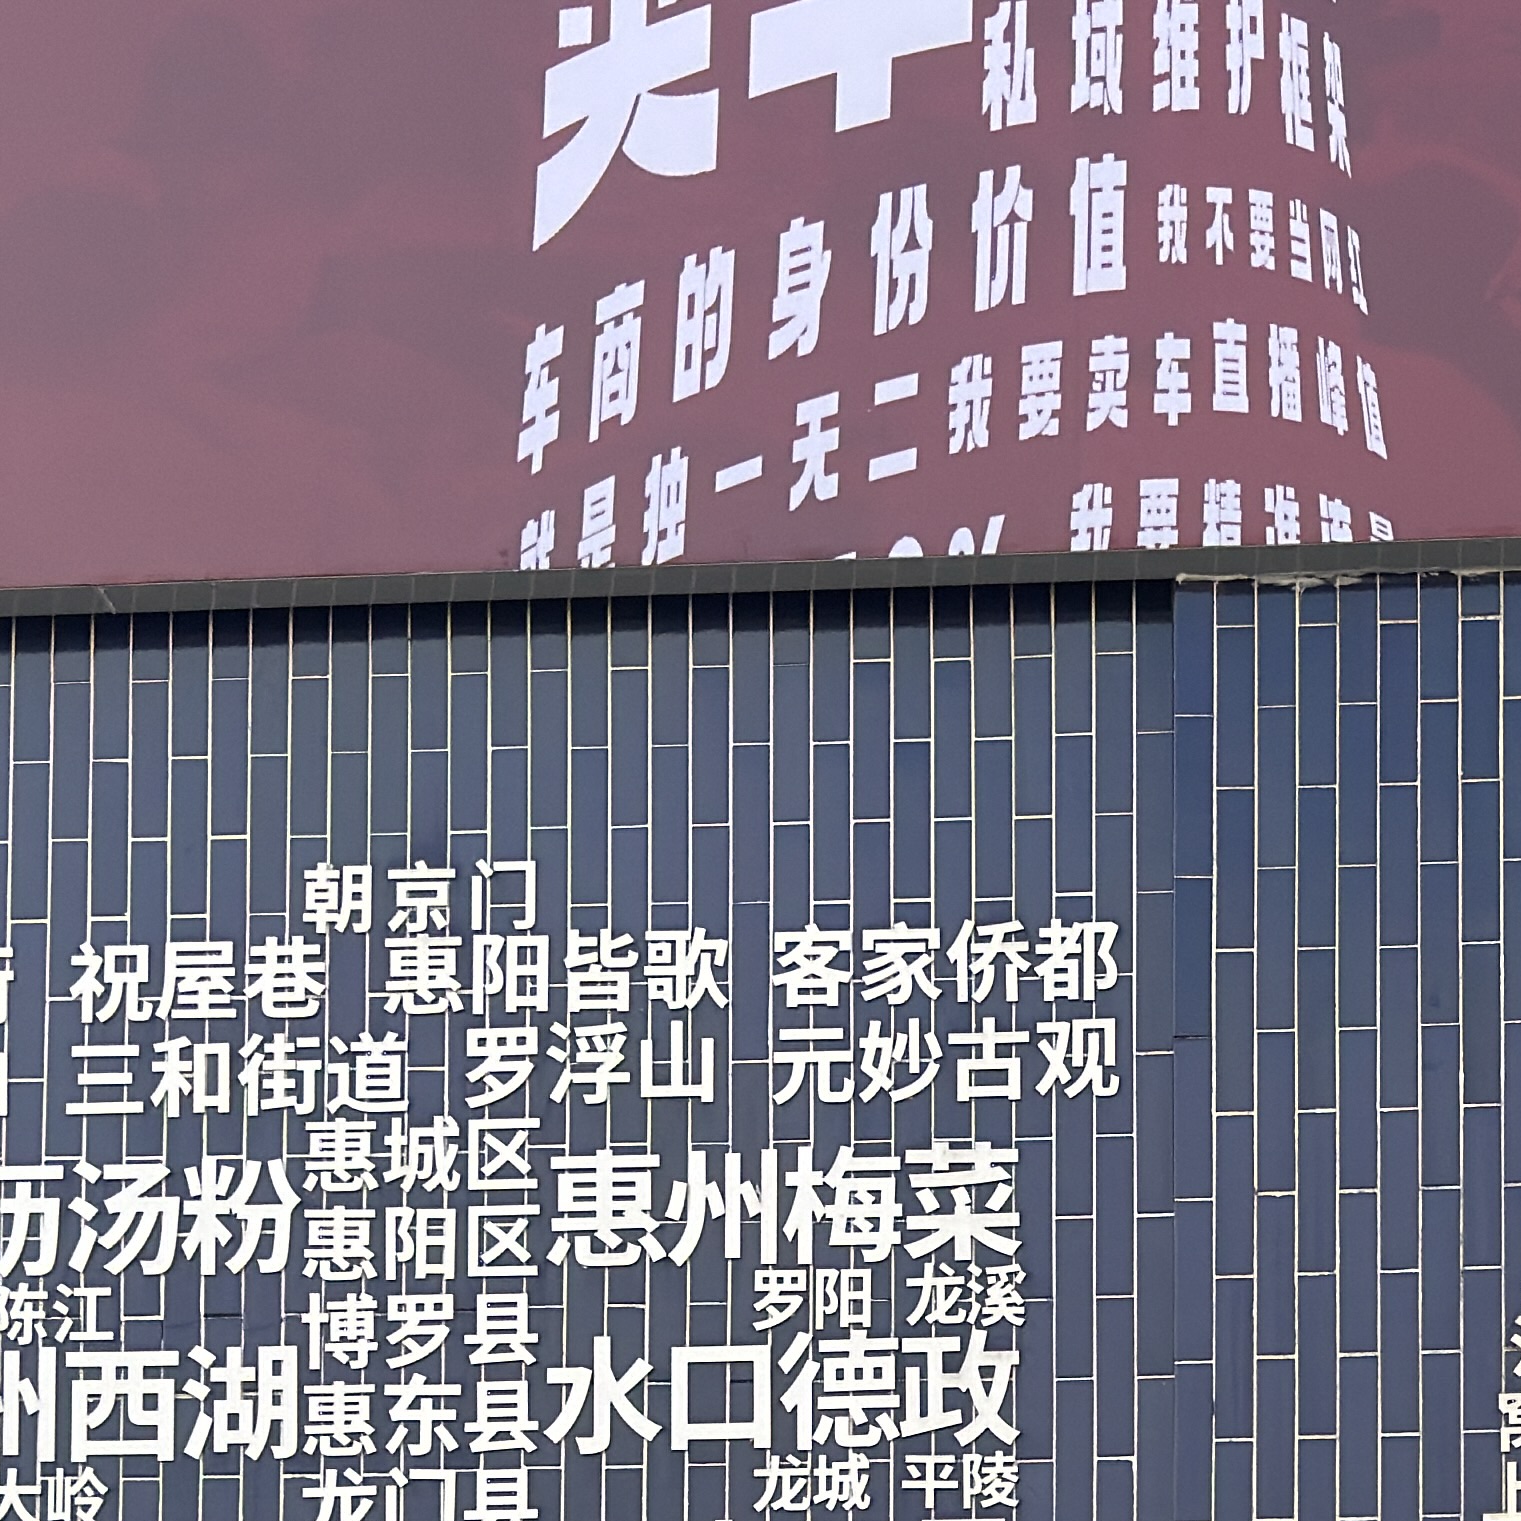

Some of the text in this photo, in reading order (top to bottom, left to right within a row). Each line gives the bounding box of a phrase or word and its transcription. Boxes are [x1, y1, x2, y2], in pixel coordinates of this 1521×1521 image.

[517, 152, 1128, 475] 车商的身份价值
[302, 859, 537, 934] 朝京门
[70, 936, 326, 1024] 祝屋巷
[384, 926, 729, 1016] 惠阳皆歌
[773, 919, 1120, 1008] 客家侨都
[66, 1032, 409, 1118] 三和街道
[464, 1021, 715, 1108] 罗浮山
[774, 1017, 1120, 1105] 元妙古观
[303, 1117, 541, 1194] 惠城区
[303, 1205, 541, 1281] 惠阳区
[547, 1142, 1022, 1268] 惠州梅菜
[301, 1292, 539, 1371] 博罗县
[753, 1262, 1027, 1331] 罗阳 龙溪
[302, 1373, 539, 1458] 惠东县
[543, 1330, 1021, 1455] 水口德政
[753, 1450, 1020, 1513] 龙城 平陵
